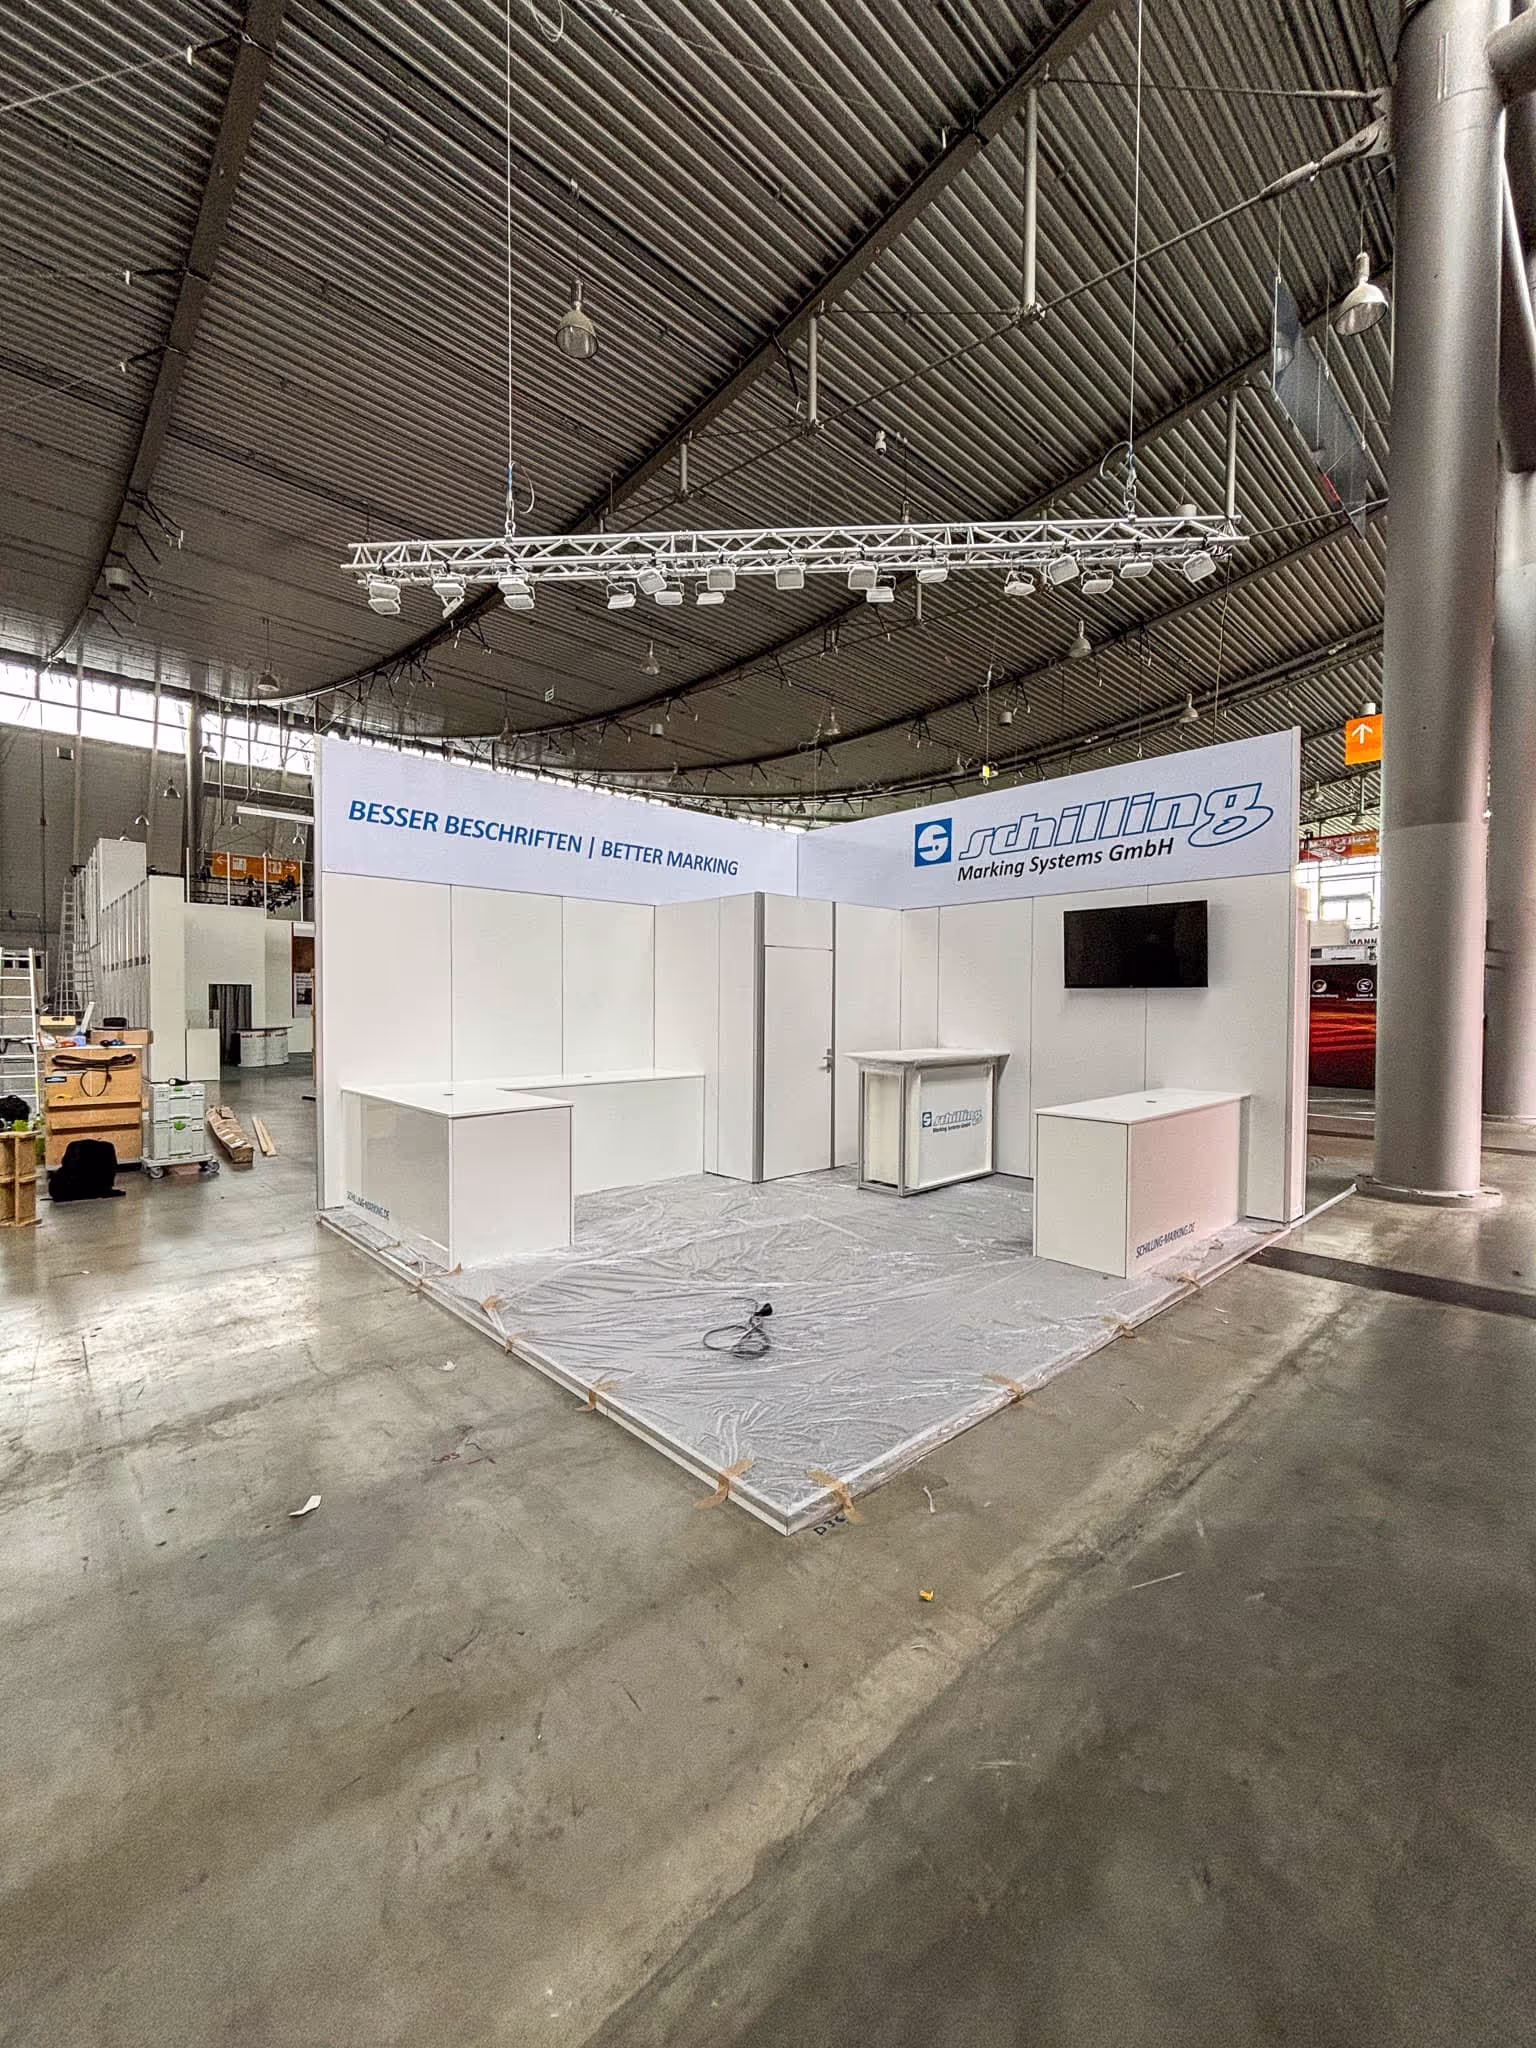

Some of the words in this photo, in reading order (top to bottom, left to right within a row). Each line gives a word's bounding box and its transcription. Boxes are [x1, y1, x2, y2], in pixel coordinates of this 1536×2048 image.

[348, 799, 439, 832] BESSER
[444, 815, 583, 853] BESCHRIFTEN
[601, 840, 663, 865] BETTER
[666, 850, 739, 876] MARKING
[957, 860, 1024, 882] Marking
[1029, 849, 1102, 876] Systems
[1109, 837, 1174, 862] GmbH
[958, 782, 1273, 860] schilling
